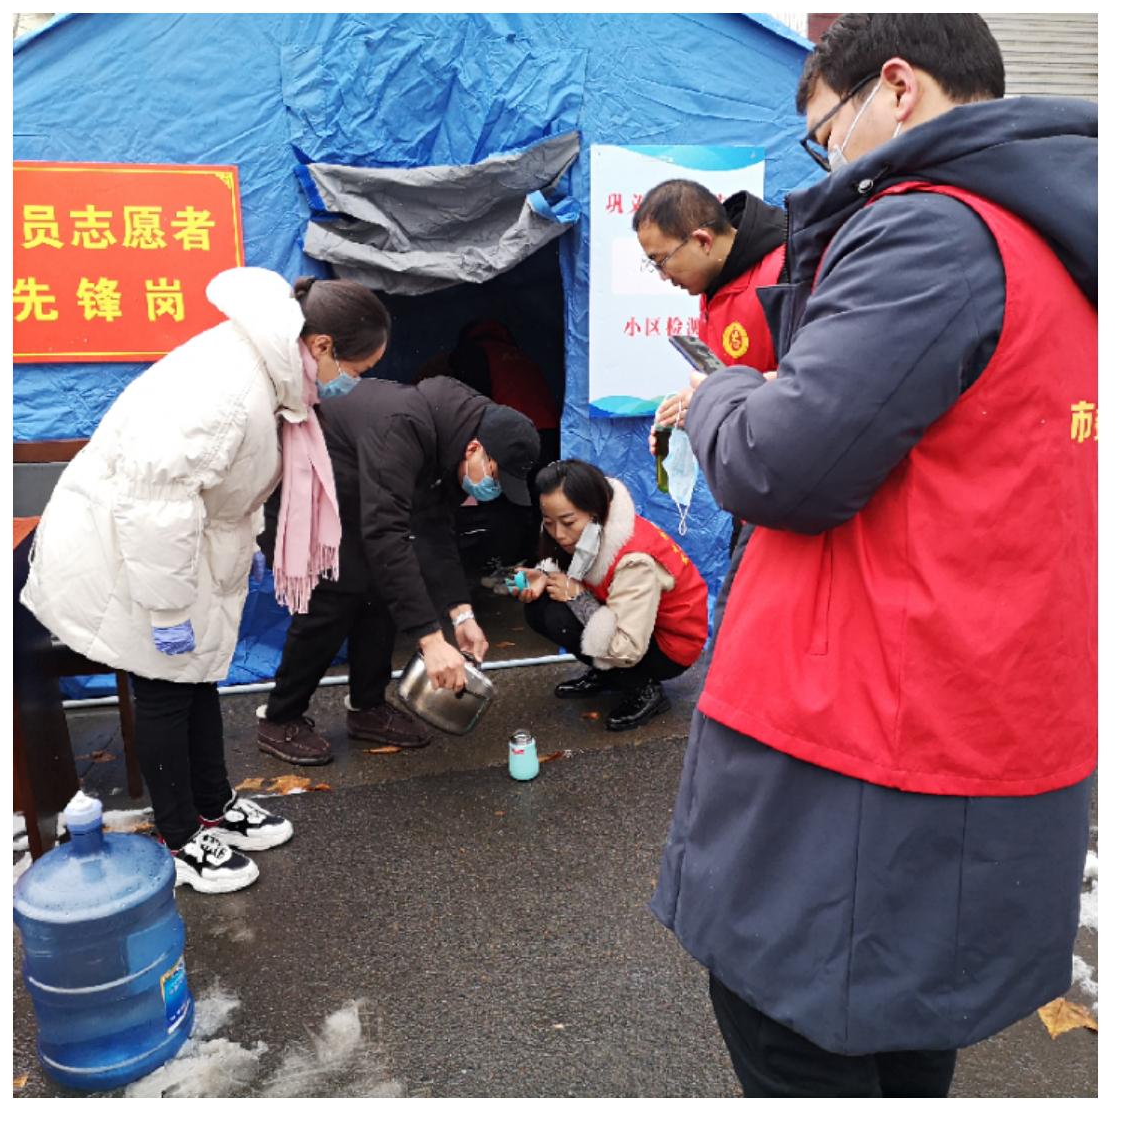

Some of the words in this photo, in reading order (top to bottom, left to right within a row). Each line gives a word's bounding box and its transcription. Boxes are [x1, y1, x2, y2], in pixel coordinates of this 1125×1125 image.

[22, 204, 216, 252] 员志愿者
[13, 277, 186, 322] 先锋岗
[1070, 400, 1098, 443] 市
